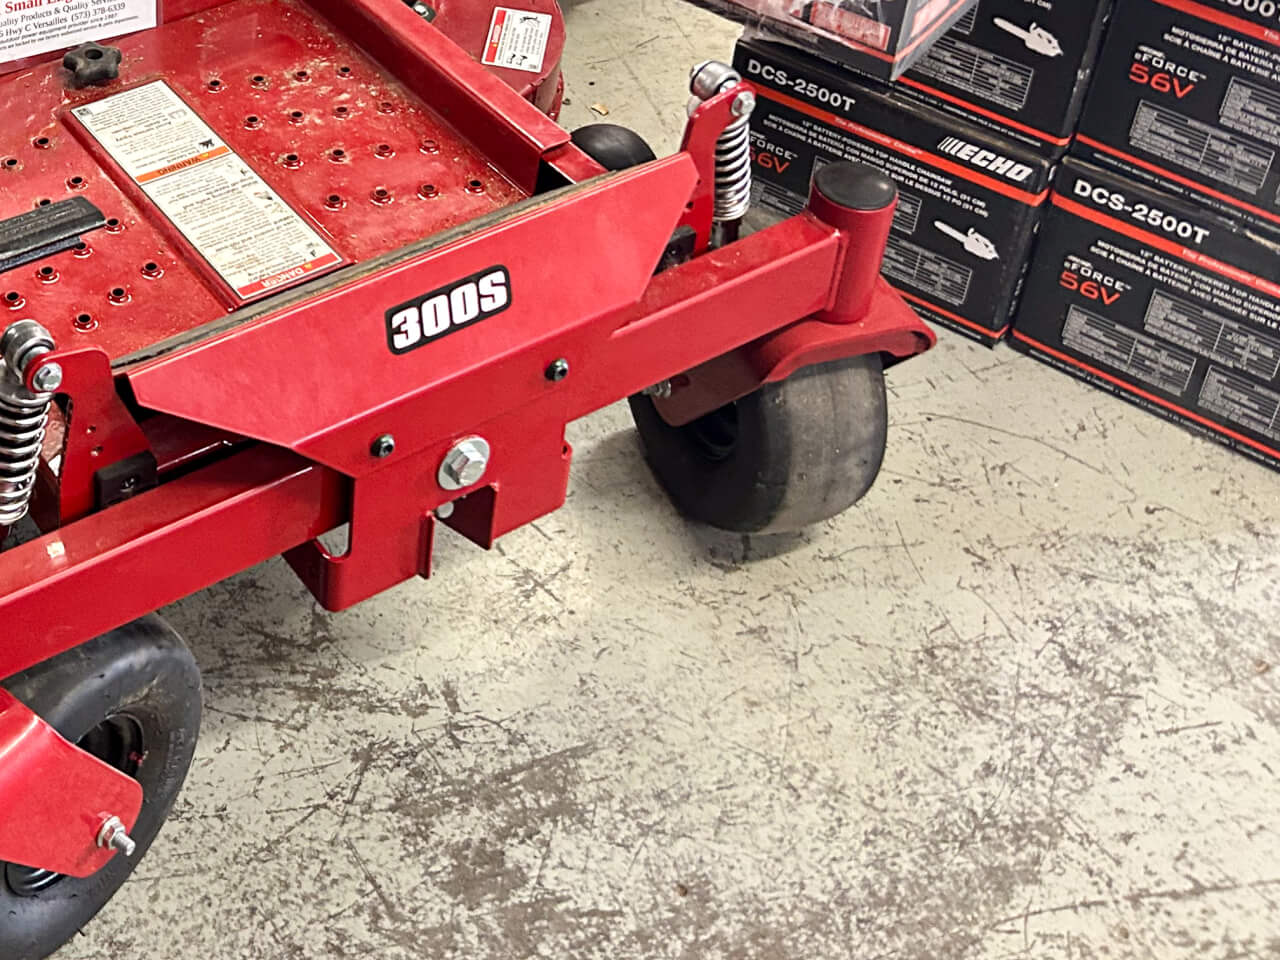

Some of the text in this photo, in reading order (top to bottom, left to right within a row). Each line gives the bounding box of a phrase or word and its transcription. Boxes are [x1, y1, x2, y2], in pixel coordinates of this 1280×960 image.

[6, 27, 22, 36] Hwy
[34, 16, 67, 29] Versailles
[71, 11, 90, 21] (573)
[92, 2, 125, 16] 378-6339
[21, 10, 52, 22] Products
[63, 2, 88, 13] Quality
[1129, 61, 1195, 98] 56V
[1134, 52, 1200, 82] eFORCE
[747, 58, 856, 111] DCS-2500T
[750, 136, 794, 160] FORCE
[946, 139, 1032, 182] ECHO
[159, 156, 201, 176] WARNING
[1073, 179, 1210, 244] DCS-2500T
[261, 268, 304, 287] DANGER
[1059, 270, 1120, 305] 56V
[1063, 261, 1126, 292] eFORCE
[392, 270, 507, 349] 300S
